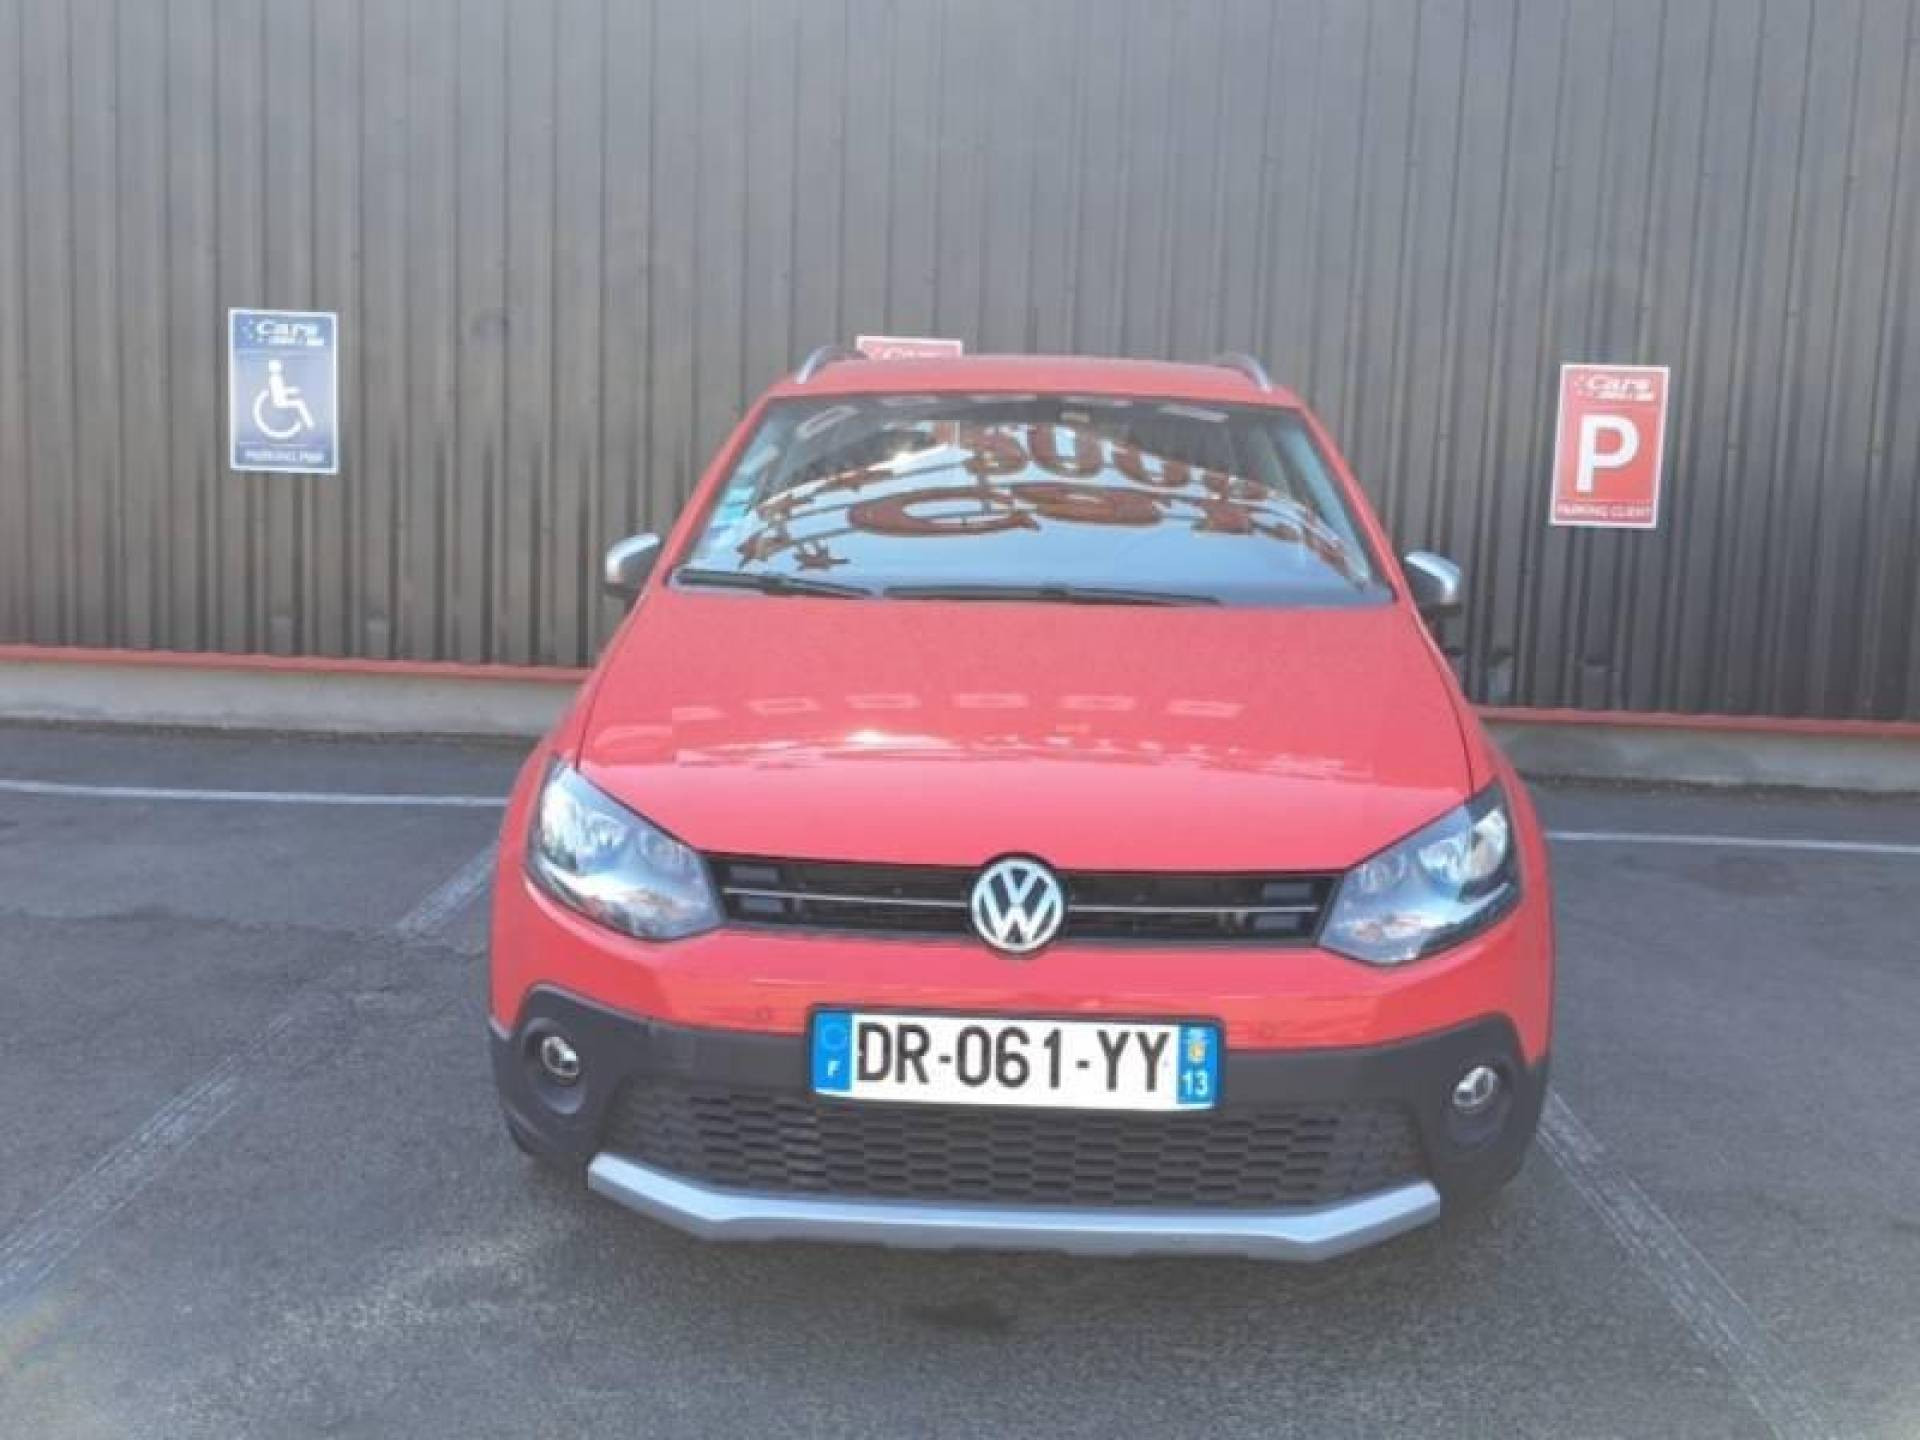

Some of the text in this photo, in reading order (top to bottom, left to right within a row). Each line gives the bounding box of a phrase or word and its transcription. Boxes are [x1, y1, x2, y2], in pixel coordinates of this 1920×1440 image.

[1576, 414, 1639, 493] P
[857, 1021, 1170, 1092] DR-061-YY
[1182, 1070, 1208, 1096] 13
